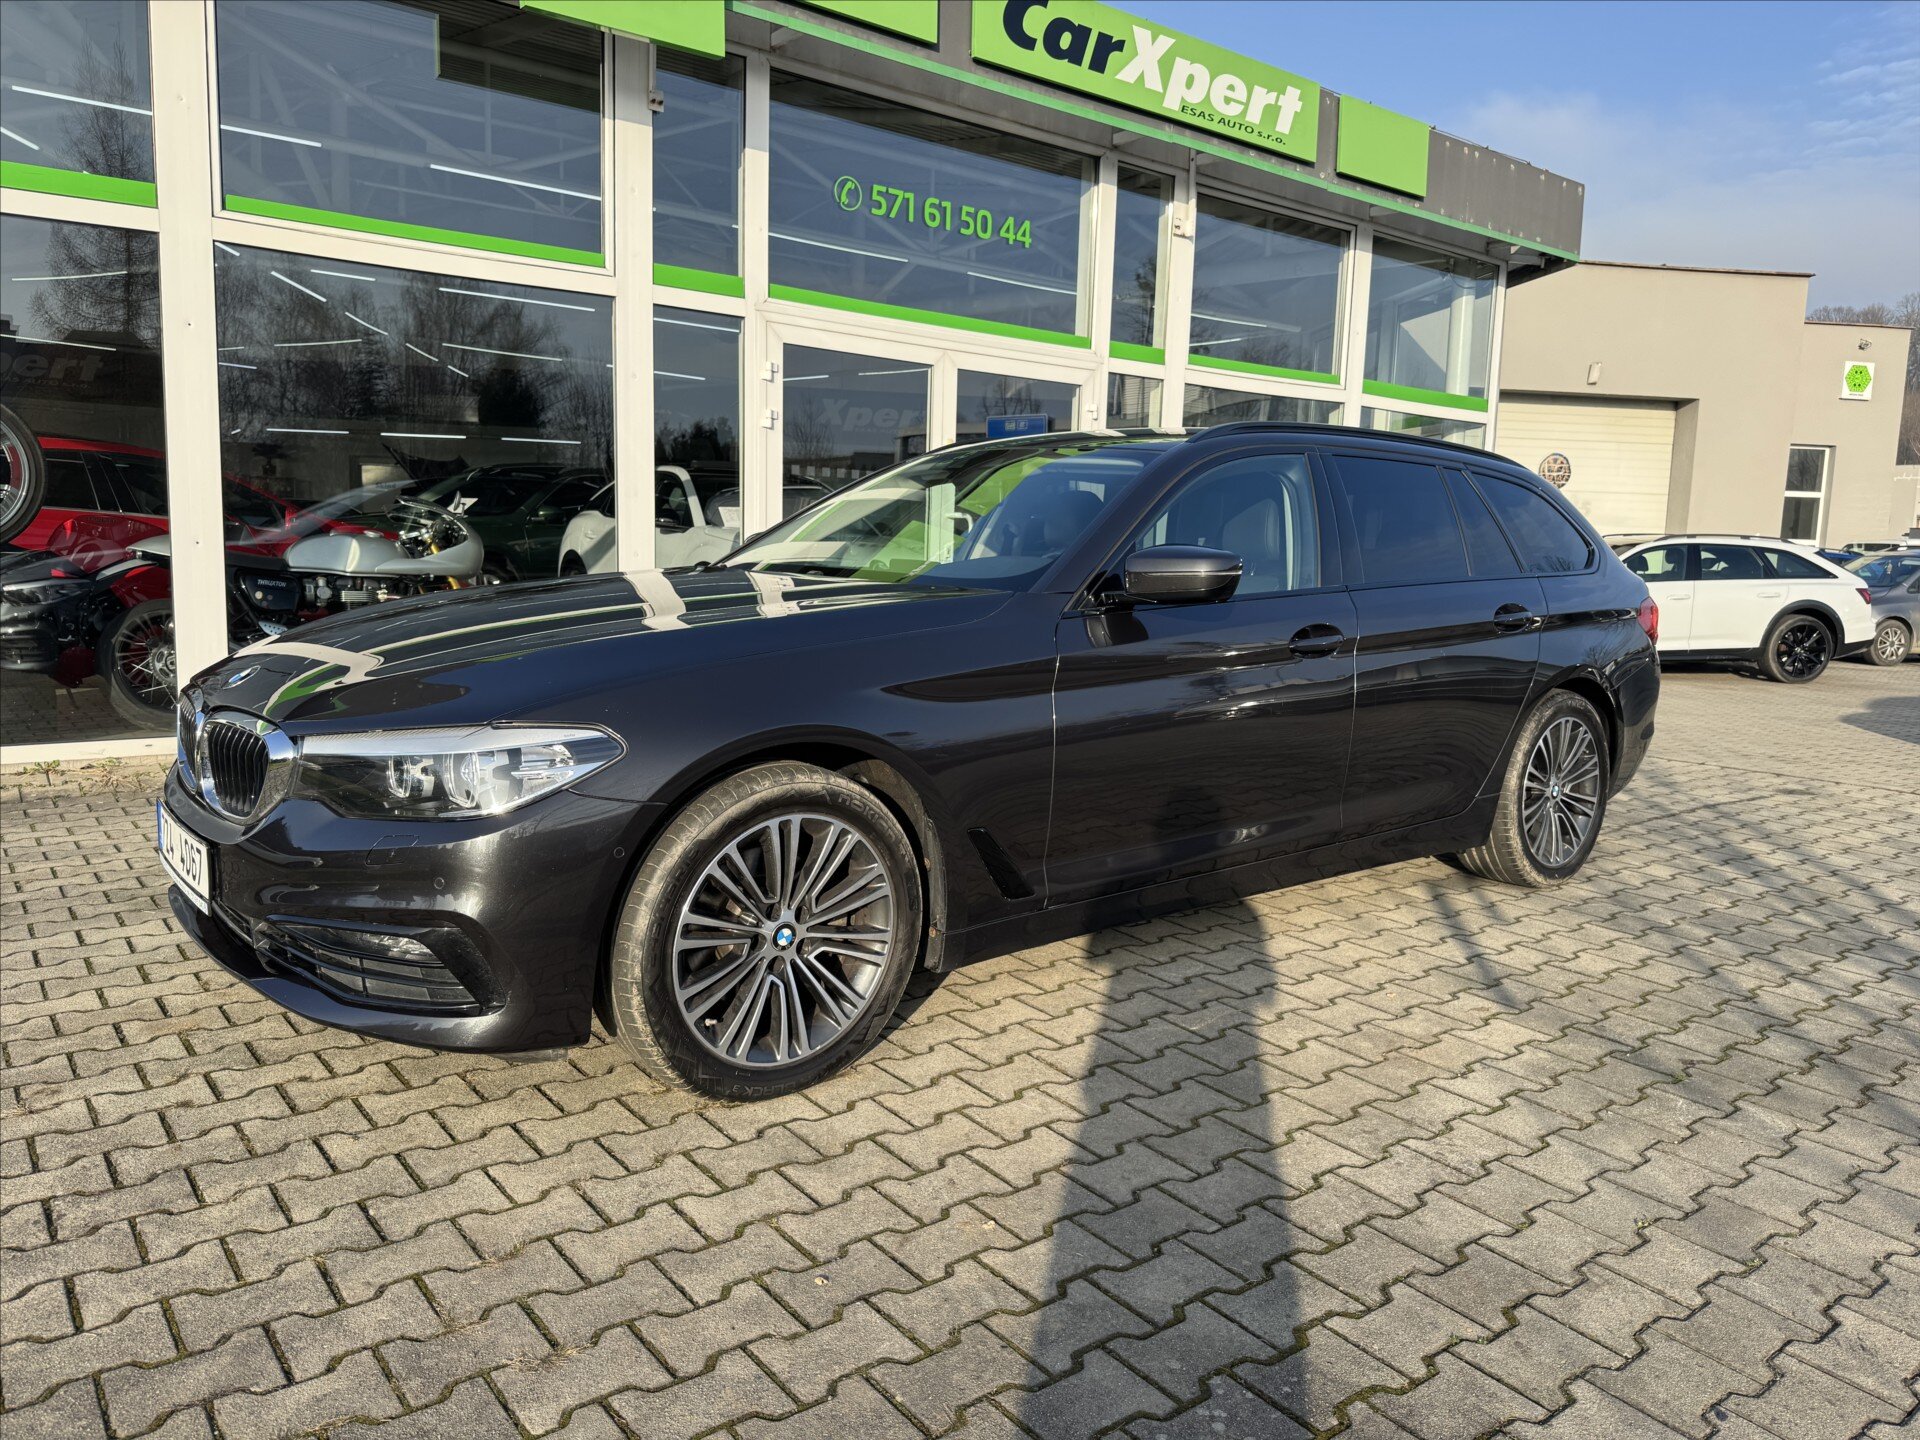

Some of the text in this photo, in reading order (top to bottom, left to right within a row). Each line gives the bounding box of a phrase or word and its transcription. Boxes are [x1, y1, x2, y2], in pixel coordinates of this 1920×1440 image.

[1002, 0, 1303, 135] CarXpert
[1180, 104, 1287, 146] ESAS AUTO s.r.o.
[871, 183, 1032, 249] 571 61 50 44
[179, 833, 202, 886] 4067
